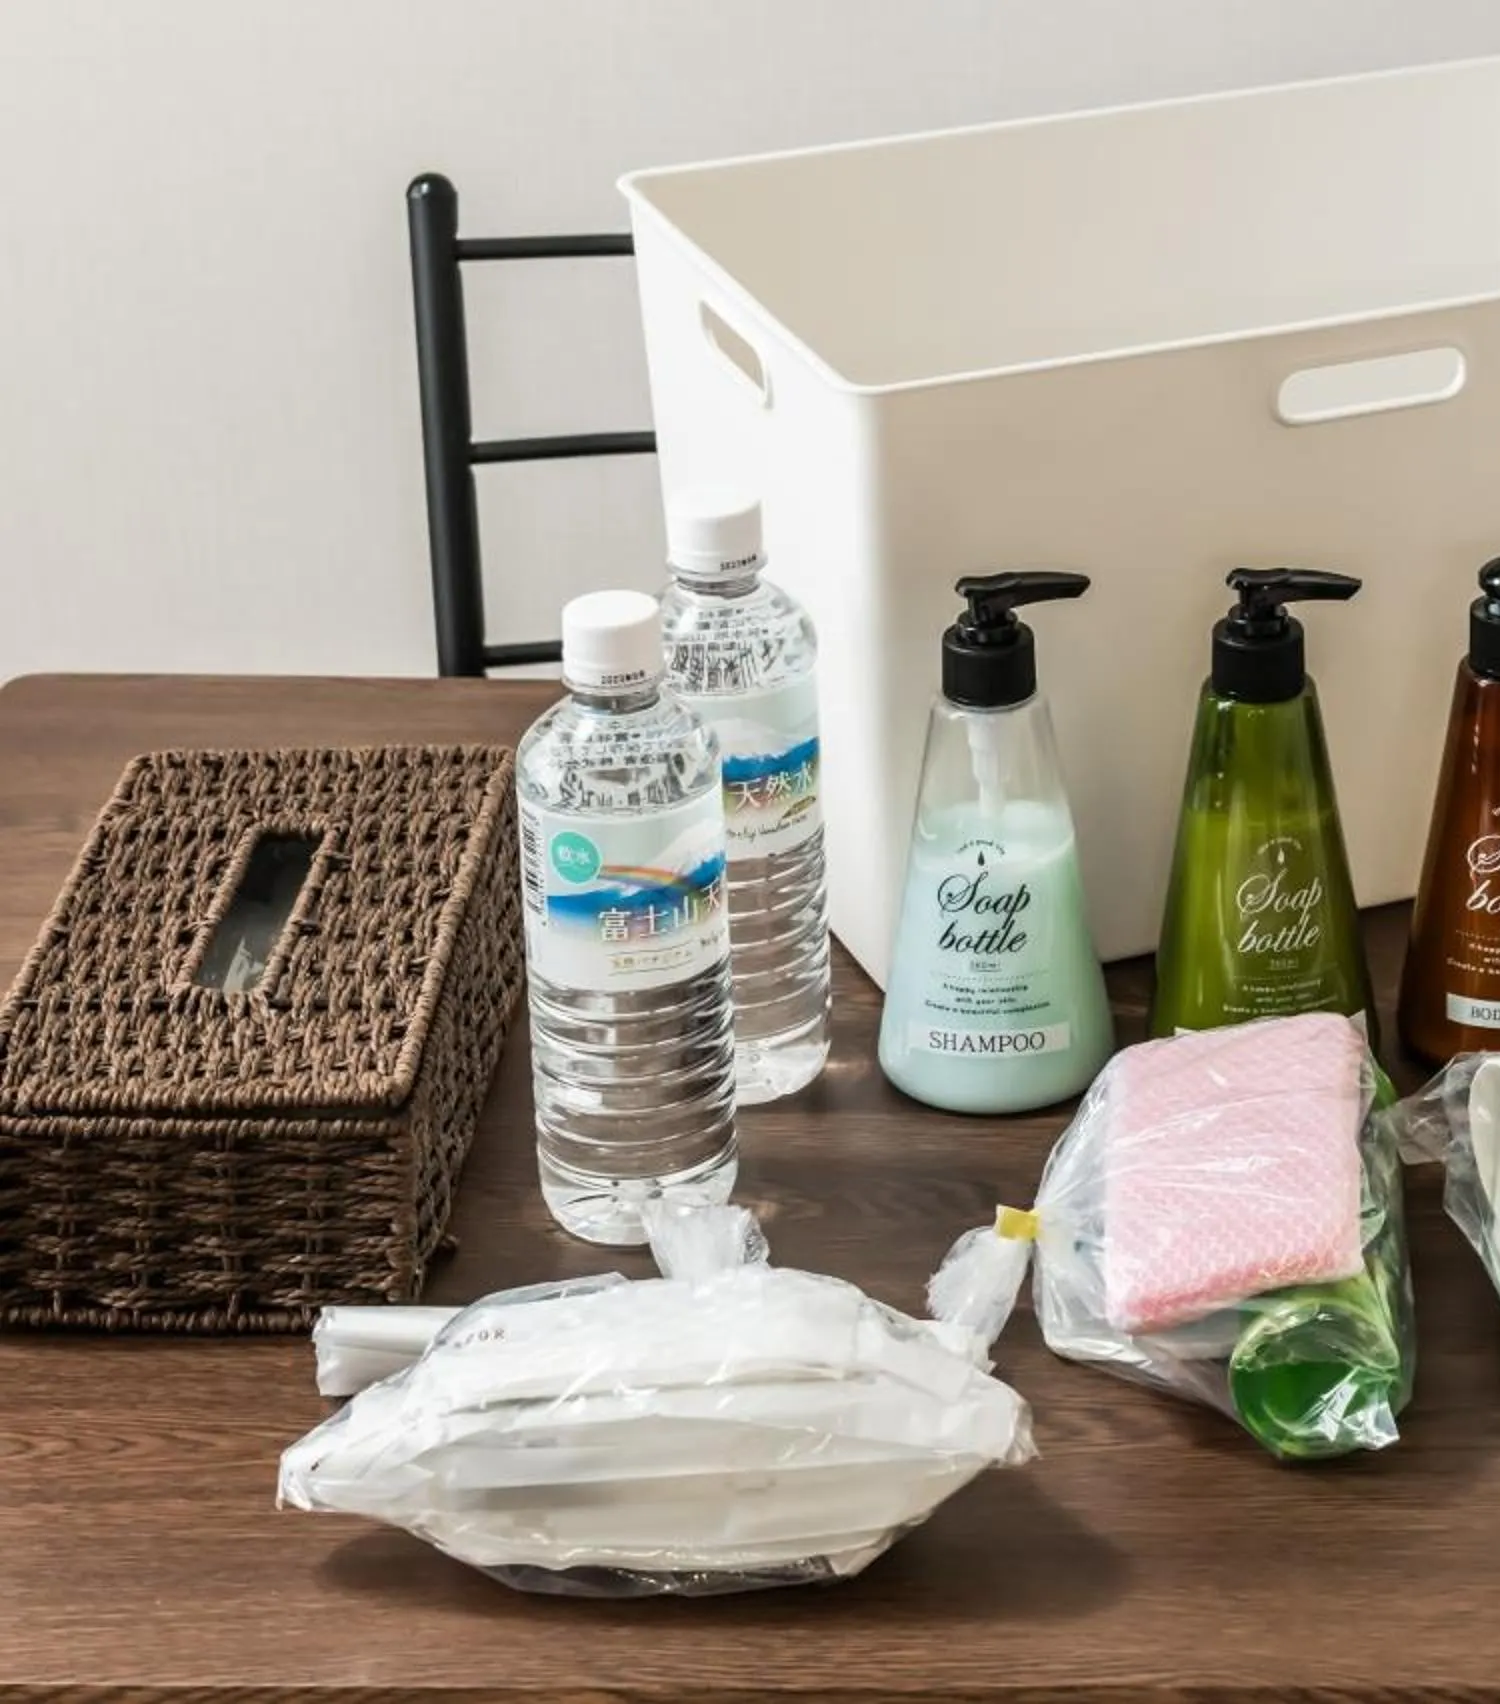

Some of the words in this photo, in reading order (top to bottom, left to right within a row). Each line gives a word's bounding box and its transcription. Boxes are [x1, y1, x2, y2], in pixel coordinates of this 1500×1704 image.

[938, 871, 1031, 930] Soap
[1236, 868, 1322, 922] Soap
[938, 919, 1028, 956] bottle
[1238, 913, 1321, 953] bottle
[929, 1031, 1046, 1054] SHAMPOO
